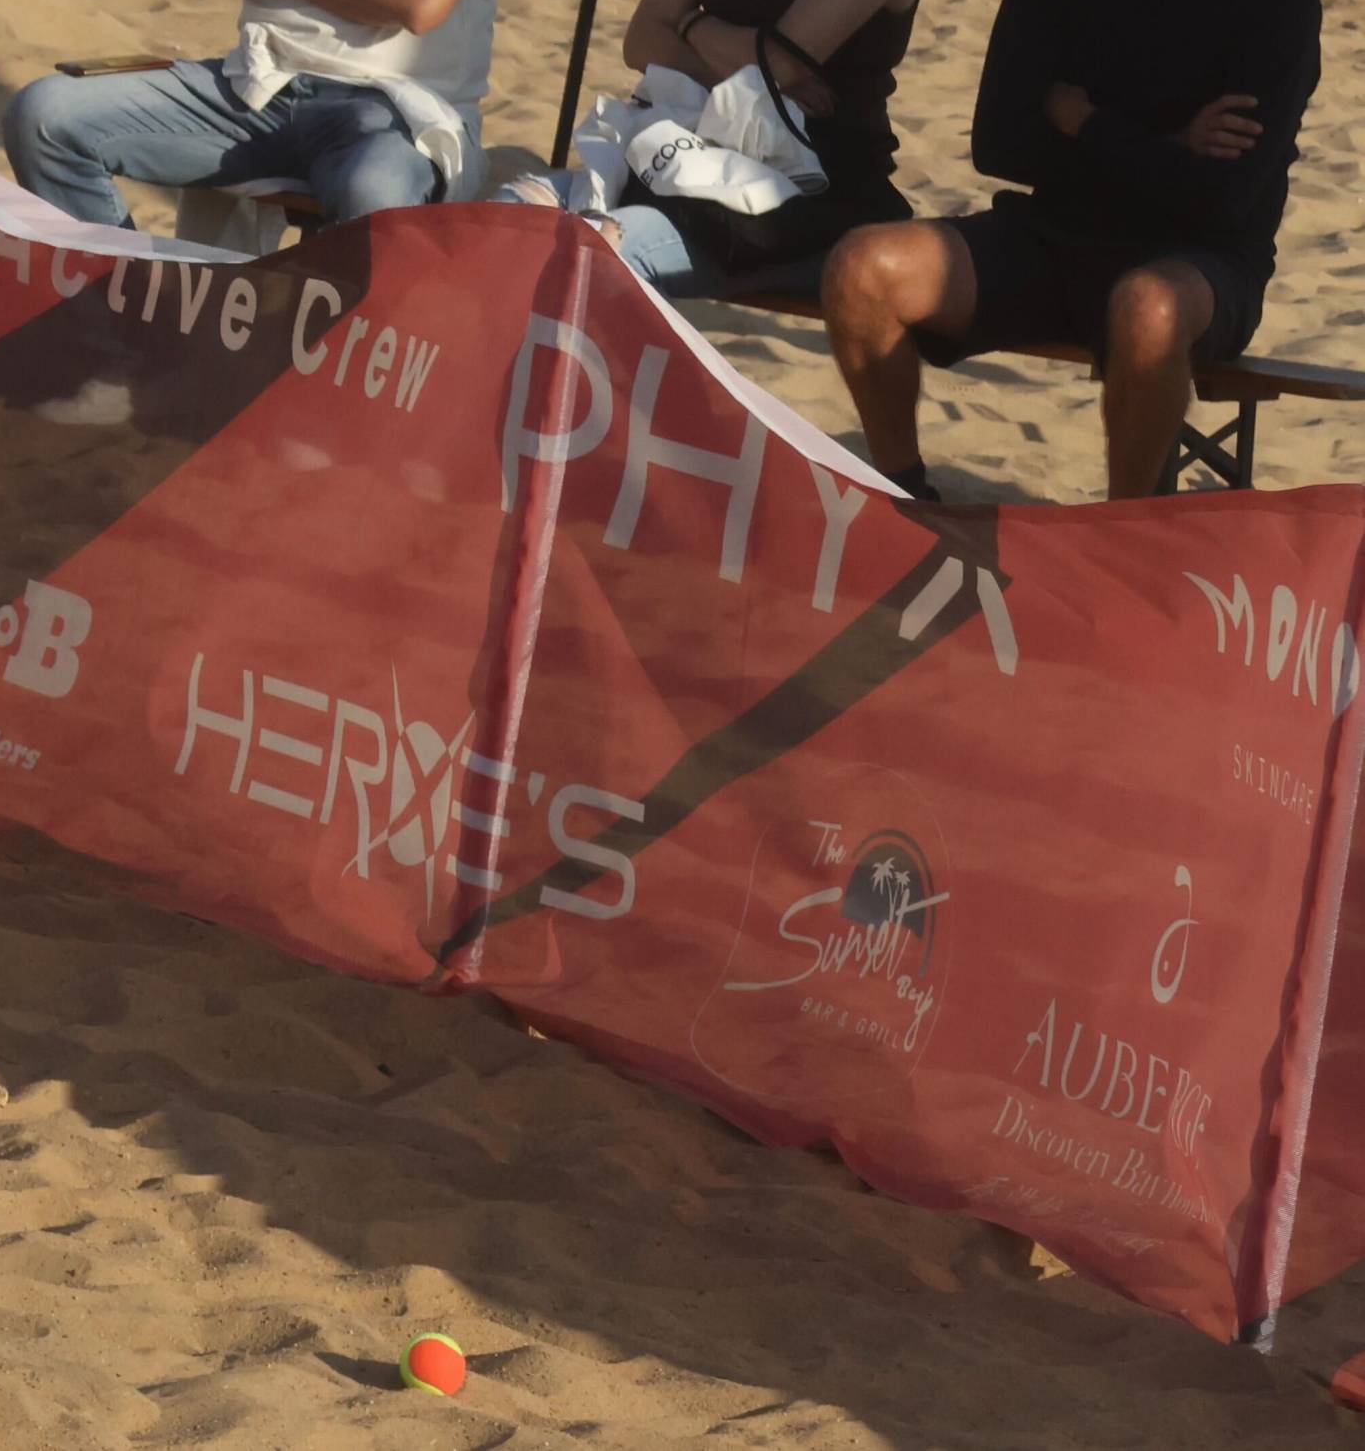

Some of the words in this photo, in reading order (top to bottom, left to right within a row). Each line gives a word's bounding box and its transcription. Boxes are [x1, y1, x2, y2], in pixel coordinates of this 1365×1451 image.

[292, 277, 440, 413] Crew
[1181, 570, 1361, 722] MONO
[1232, 743, 1315, 825] SKINCARE
[808, 820, 848, 868] The
[723, 885, 951, 991] Sunset
[800, 996, 835, 1023] BAR
[1011, 997, 1213, 1158] AUBERGE
